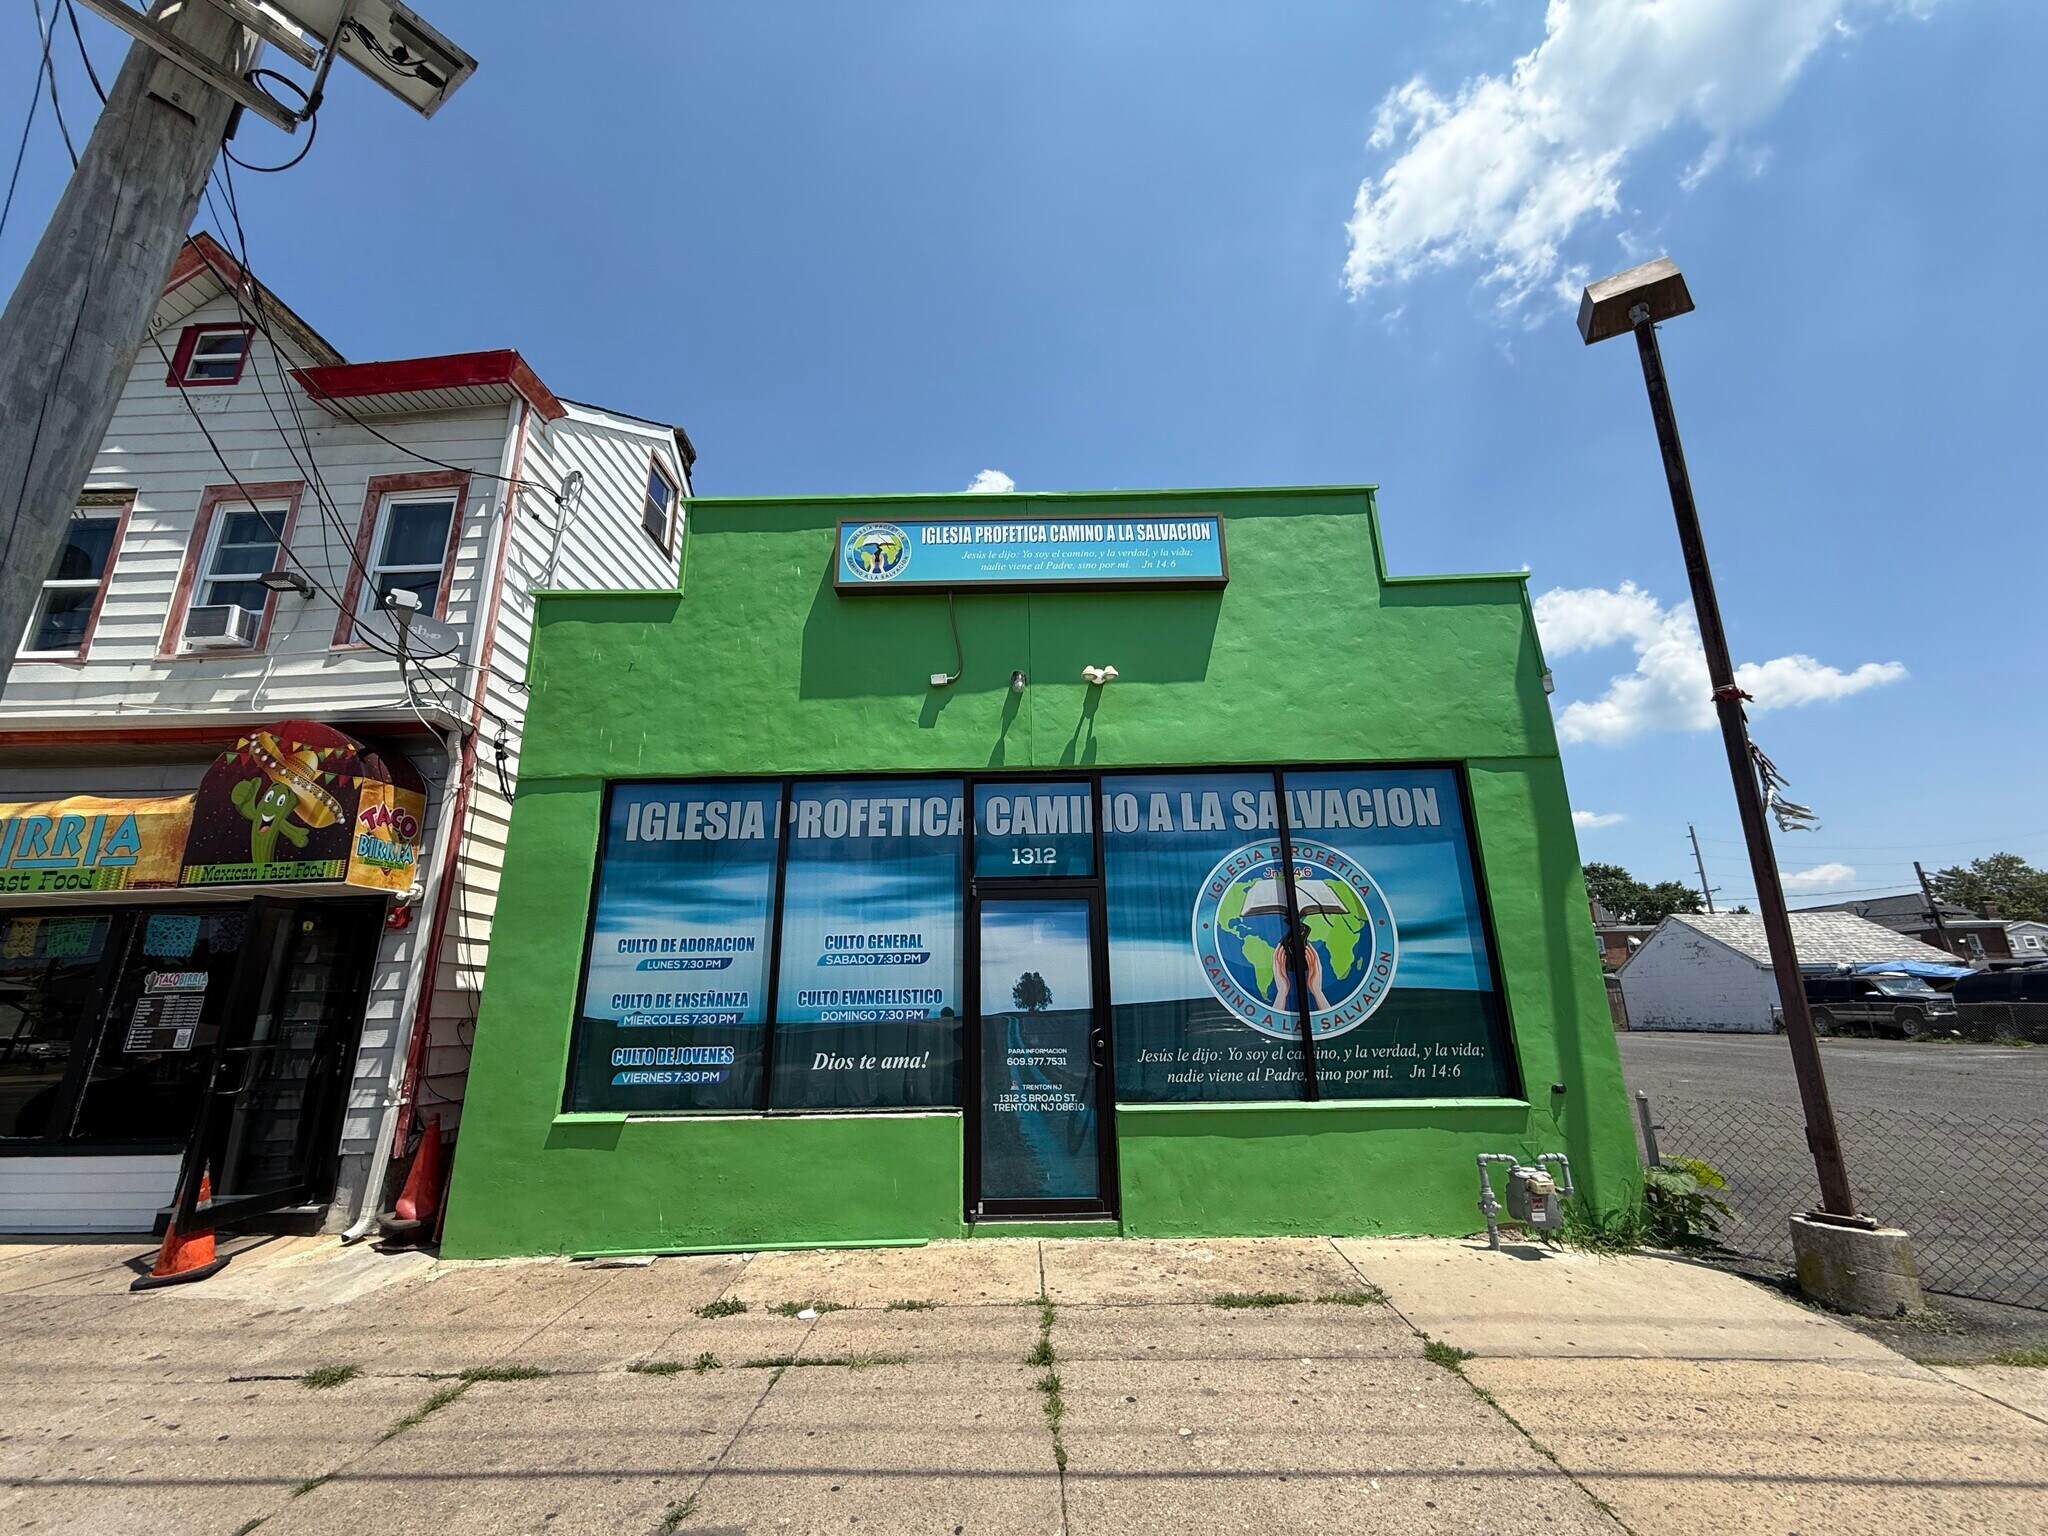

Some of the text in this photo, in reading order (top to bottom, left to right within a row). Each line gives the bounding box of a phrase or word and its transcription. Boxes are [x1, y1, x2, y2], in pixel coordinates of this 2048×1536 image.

[922, 523, 1211, 544] IGLESIA PROFETICA CAMINO A LA SALVACION
[961, 547, 1194, 561] Jesús le dijo: Yo soy el camino, y la verdad, y la vida;
[980, 562, 1006, 571] nadie
[1008, 562, 1032, 570] viene
[1034, 562, 1044, 570] al
[1046, 561, 1075, 570] Padre,
[1078, 560, 1097, 569] sino
[1099, 562, 1115, 570] por
[1142, 560, 1176, 569] Jn 14:6
[358, 801, 418, 840] TACO
[626, 787, 1442, 842] IGLESIA PROFETICA CAMINO A LA SALVACION
[0, 811, 141, 868] IRRIA
[356, 834, 414, 864] BIRRIA
[1012, 848, 1056, 864] 1312
[201, 862, 327, 882] Mexican Fast Food
[1208, 846, 1370, 899] IGLESIA PROFÉTICA
[1263, 867, 1279, 878] Jn
[0, 870, 96, 892] ast Food
[618, 937, 756, 954] CULTO DE ADORACION
[824, 934, 924, 950] CULTO GENERAL
[647, 960, 721, 970] LUNES 7:30 PM
[826, 954, 921, 964] SABADO 7:30 PM
[612, 990, 749, 1009] CULTO DE ENSEÑANZA
[798, 988, 943, 1007] CULTO EVANGELISTICO
[1204, 955, 1256, 1016] CAMINO
[1262, 1014, 1273, 1028] A
[1320, 952, 1392, 1030] SALVACIÓN
[624, 1014, 737, 1025] MIERCOLES 7:30 PM
[821, 1010, 924, 1021] DOMINGO 7:30 PM
[612, 1046, 734, 1066] CULTO DE JOVENES
[811, 1050, 930, 1070] Dios te ama!
[1137, 1049, 1174, 1062] Jesús
[1177, 1048, 1189, 1062] le
[1192, 1048, 1223, 1064] dijo:
[1228, 1048, 1242, 1060] Yo
[1246, 1050, 1268, 1064] soy
[1272, 1047, 1284, 1060] el
[1343, 1050, 1352, 1062] y
[1355, 1044, 1368, 1058] la
[1372, 1044, 1420, 1059] verdad,
[1424, 1048, 1432, 1060] y
[1435, 1043, 1448, 1057] la
[1452, 1042, 1485, 1058] vida;
[1006, 1058, 1067, 1066] 609.977.7531
[622, 1072, 720, 1083] VIERNES 7:30 PM
[1167, 1064, 1394, 1084] nadie viene al Padre, sino por mí.
[1410, 1064, 1461, 1078] Jn 14:6
[1000, 1094, 1078, 1102] 1312 S BROAD ST.
[992, 1103, 1084, 1112] TRENTON, NJ 08610
